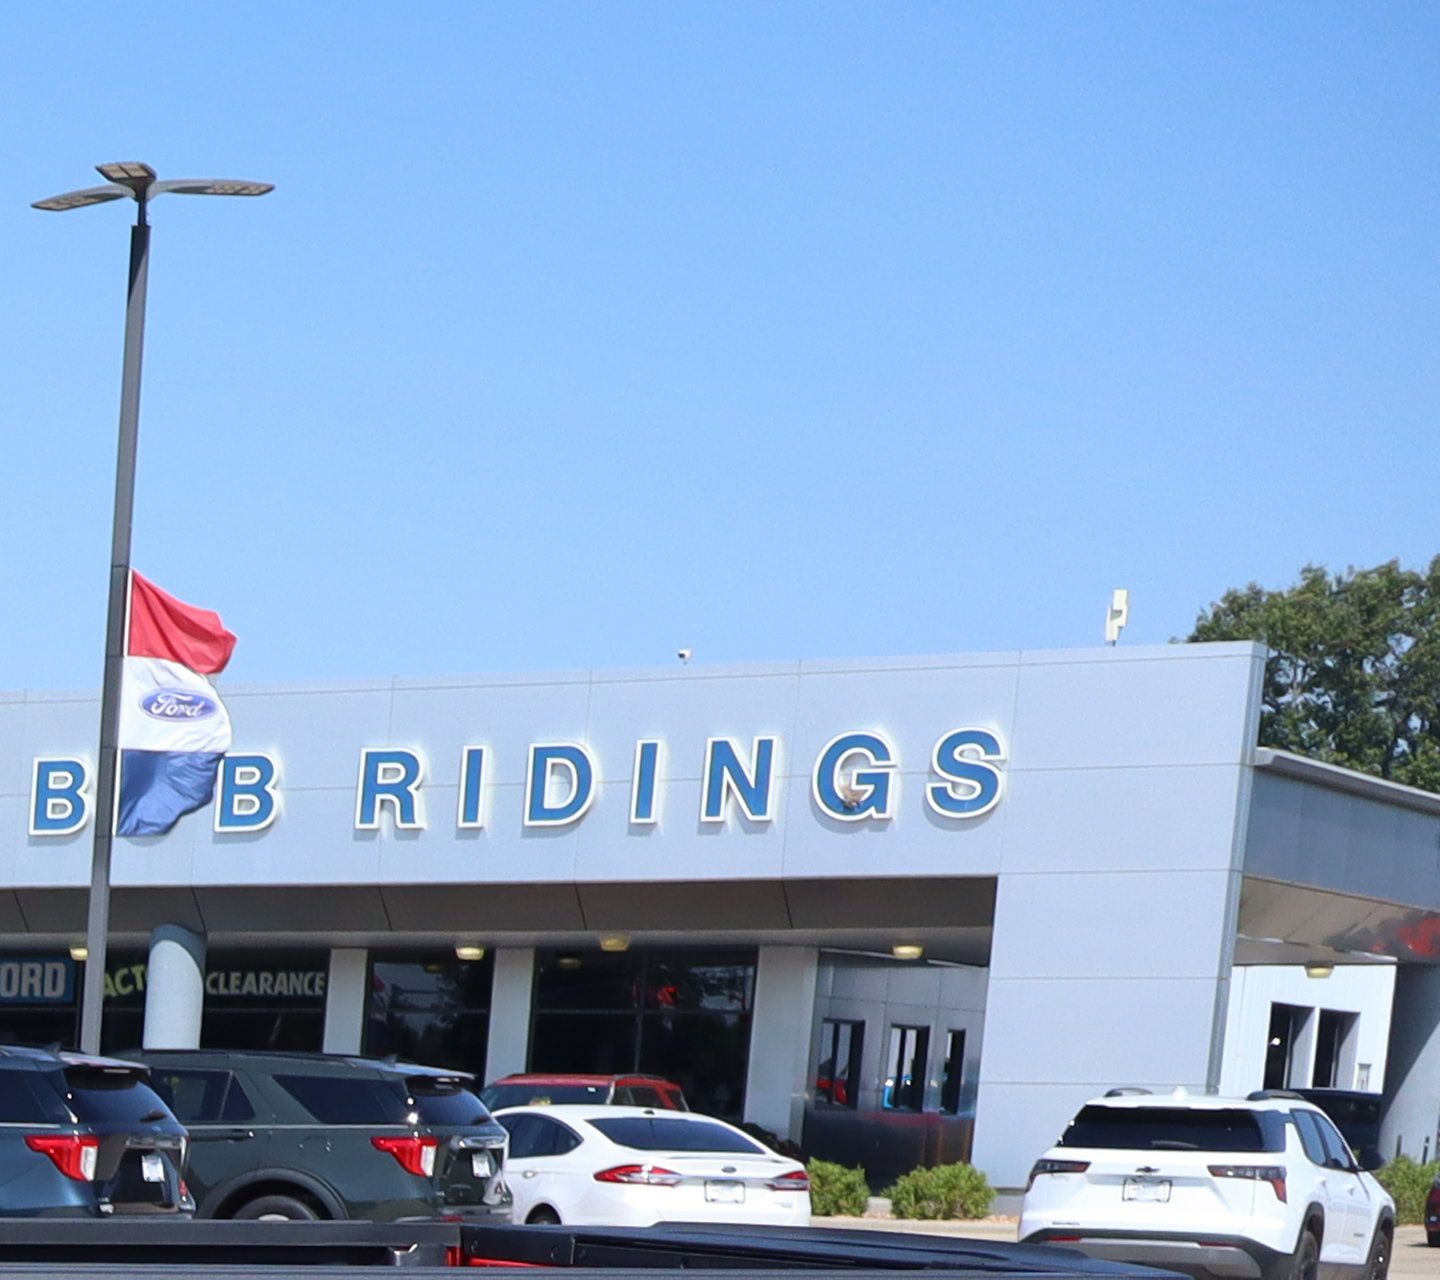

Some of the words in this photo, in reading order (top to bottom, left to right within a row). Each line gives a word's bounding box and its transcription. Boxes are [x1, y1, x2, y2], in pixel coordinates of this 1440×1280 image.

[150, 692, 205, 717] Ford
[29, 752, 279, 836] BB
[354, 727, 1008, 831] RIDINGS
[205, 971, 326, 996] CLEARANCE
